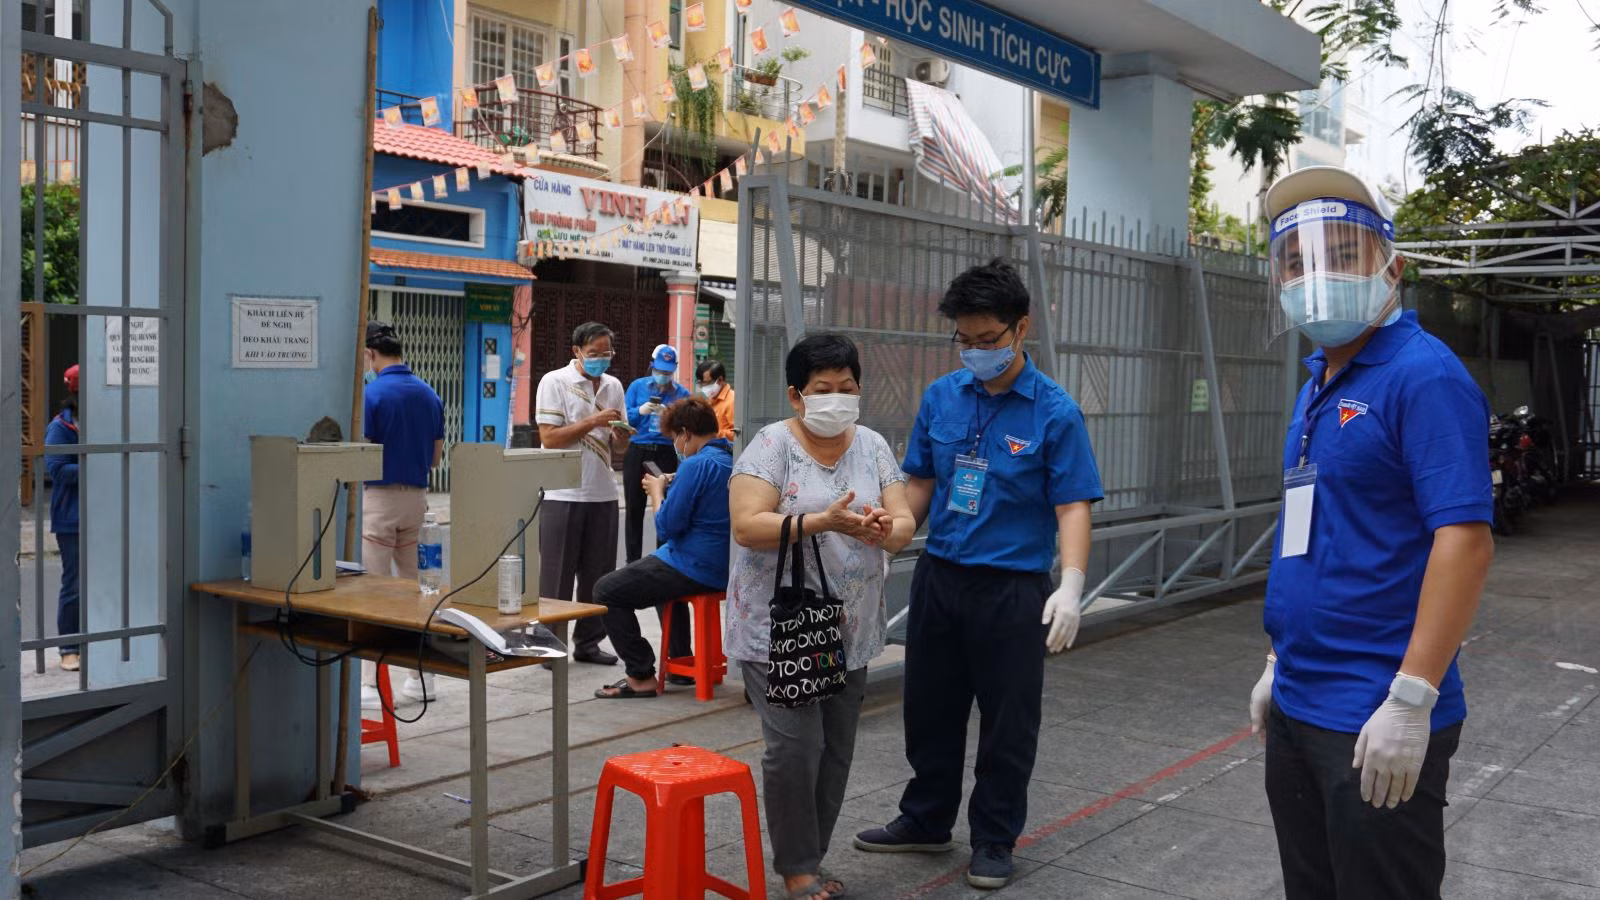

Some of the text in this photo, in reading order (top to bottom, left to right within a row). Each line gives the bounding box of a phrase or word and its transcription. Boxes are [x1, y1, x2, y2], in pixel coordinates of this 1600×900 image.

[886, 0, 1072, 86] HỌC SINH TÍCH CỰC
[579, 186, 647, 221] VINH
[1304, 205, 1337, 217] Shield
[247, 308, 274, 318] KHÁCH
[272, 321, 292, 330] NGHỊ
[284, 336, 309, 345] TRANG
[245, 350, 259, 358] KHI
